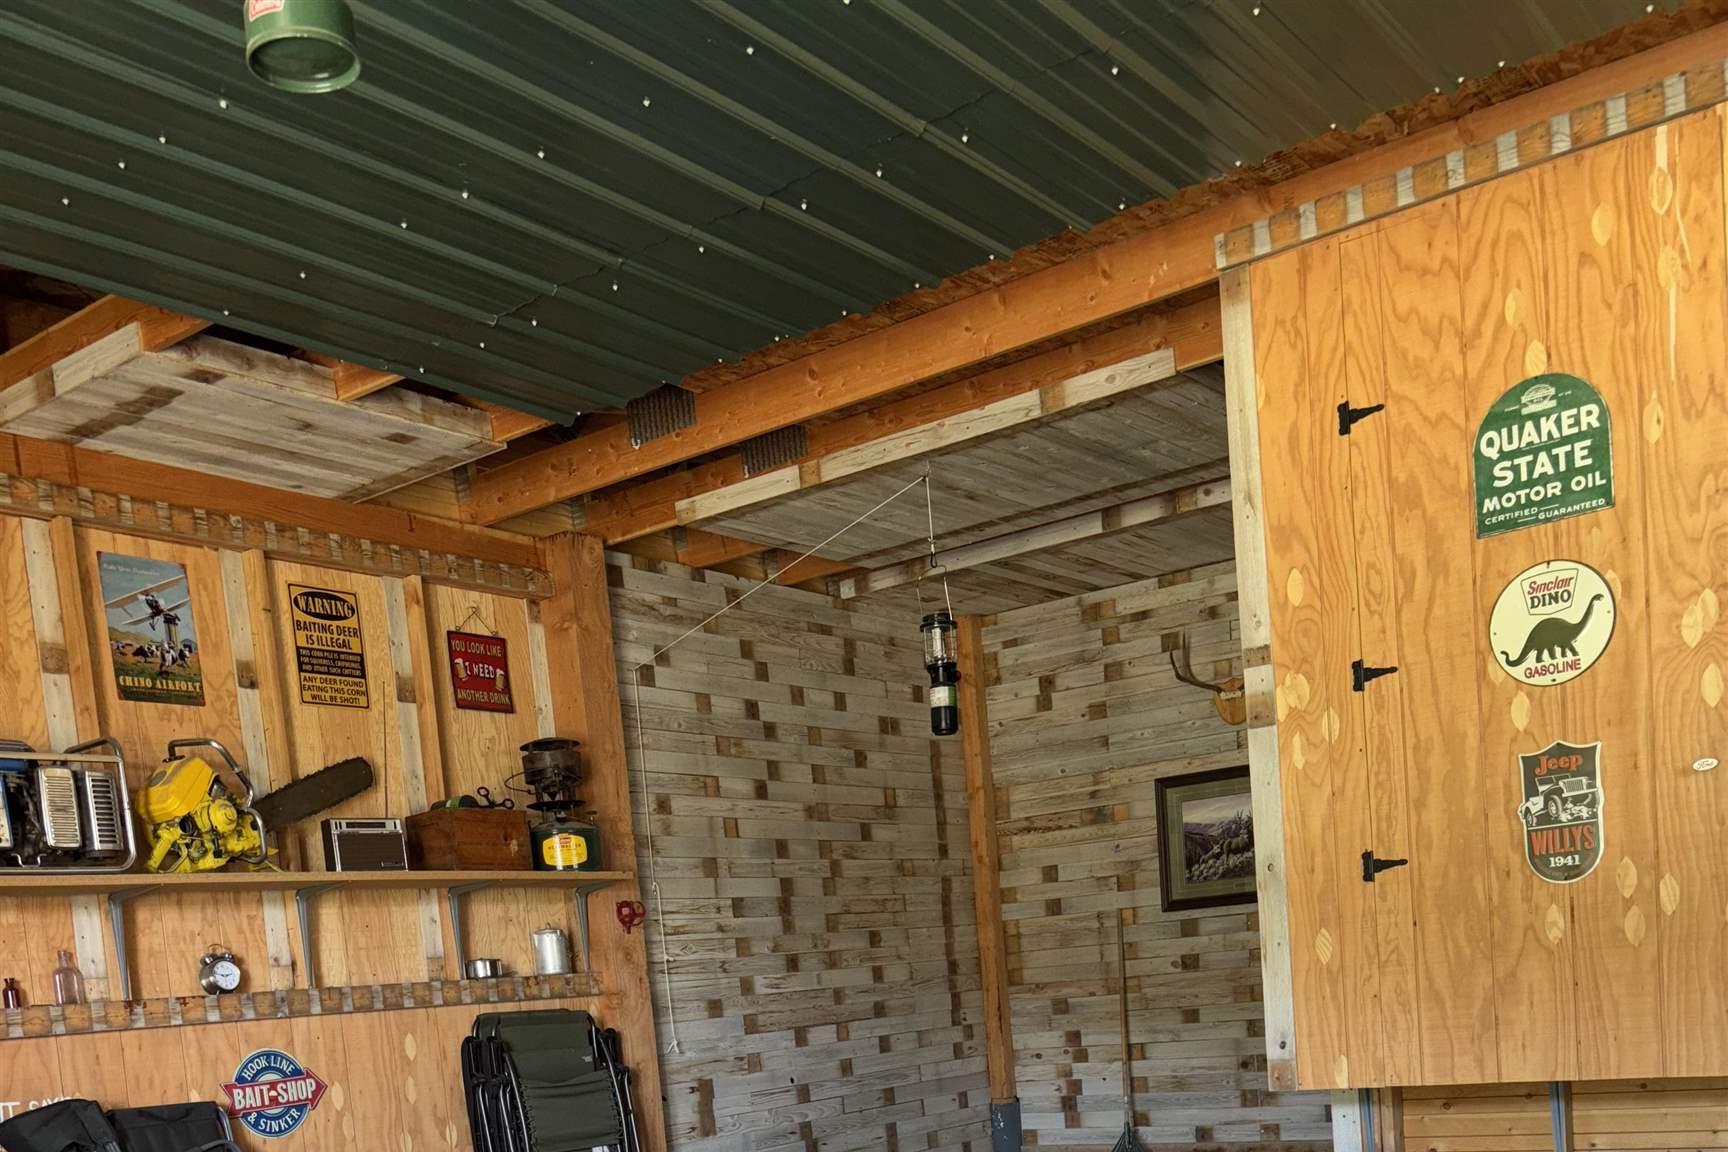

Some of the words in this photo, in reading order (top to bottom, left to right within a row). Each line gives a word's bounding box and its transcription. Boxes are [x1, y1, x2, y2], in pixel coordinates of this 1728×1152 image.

[1480, 403, 1600, 461] QUAKER
[1493, 439, 1593, 488] STATE
[1482, 481, 1562, 514] MOTOR
[1571, 471, 1607, 492] OIL
[1484, 507, 1538, 526] CERTIFIED
[1538, 497, 1606, 520] GUARANTEED
[1528, 576, 1574, 596] Sinclair
[298, 595, 353, 617] WARNING
[1530, 589, 1572, 609] DINO
[296, 620, 334, 634] BAITING
[336, 625, 359, 638] DEER
[305, 634, 315, 646] IS
[316, 635, 353, 650] ILLEGAL
[451, 639, 466, 652] YOU
[466, 641, 485, 654] LOOK
[486, 645, 502, 657] LIKE
[465, 661, 471, 675] I
[473, 663, 495, 679] NEED
[1524, 658, 1582, 679] GASOLINE
[119, 675, 152, 687] CHINO
[156, 679, 201, 692] AIRPORT
[303, 675, 317, 684] ANY
[320, 677, 338, 686] DEER
[339, 679, 364, 688] FOUND
[303, 685, 328, 694] EATING
[330, 687, 345, 695] THIS
[346, 688, 366, 696] CORN
[311, 693, 328, 702] WILL
[329, 695, 338, 703] BE
[340, 696, 361, 705] SHOT!
[457, 688, 489, 703] ANOTHER
[489, 692, 511, 704] DRINK
[1535, 754, 1583, 776] Jeep
[1530, 824, 1595, 857] WILLYS
[1548, 854, 1581, 868] 1941
[241, 1055, 269, 1080] HOOK
[271, 1055, 296, 1075] LINE
[247, 1111, 257, 1124] &
[258, 1108, 301, 1133] SINKER
